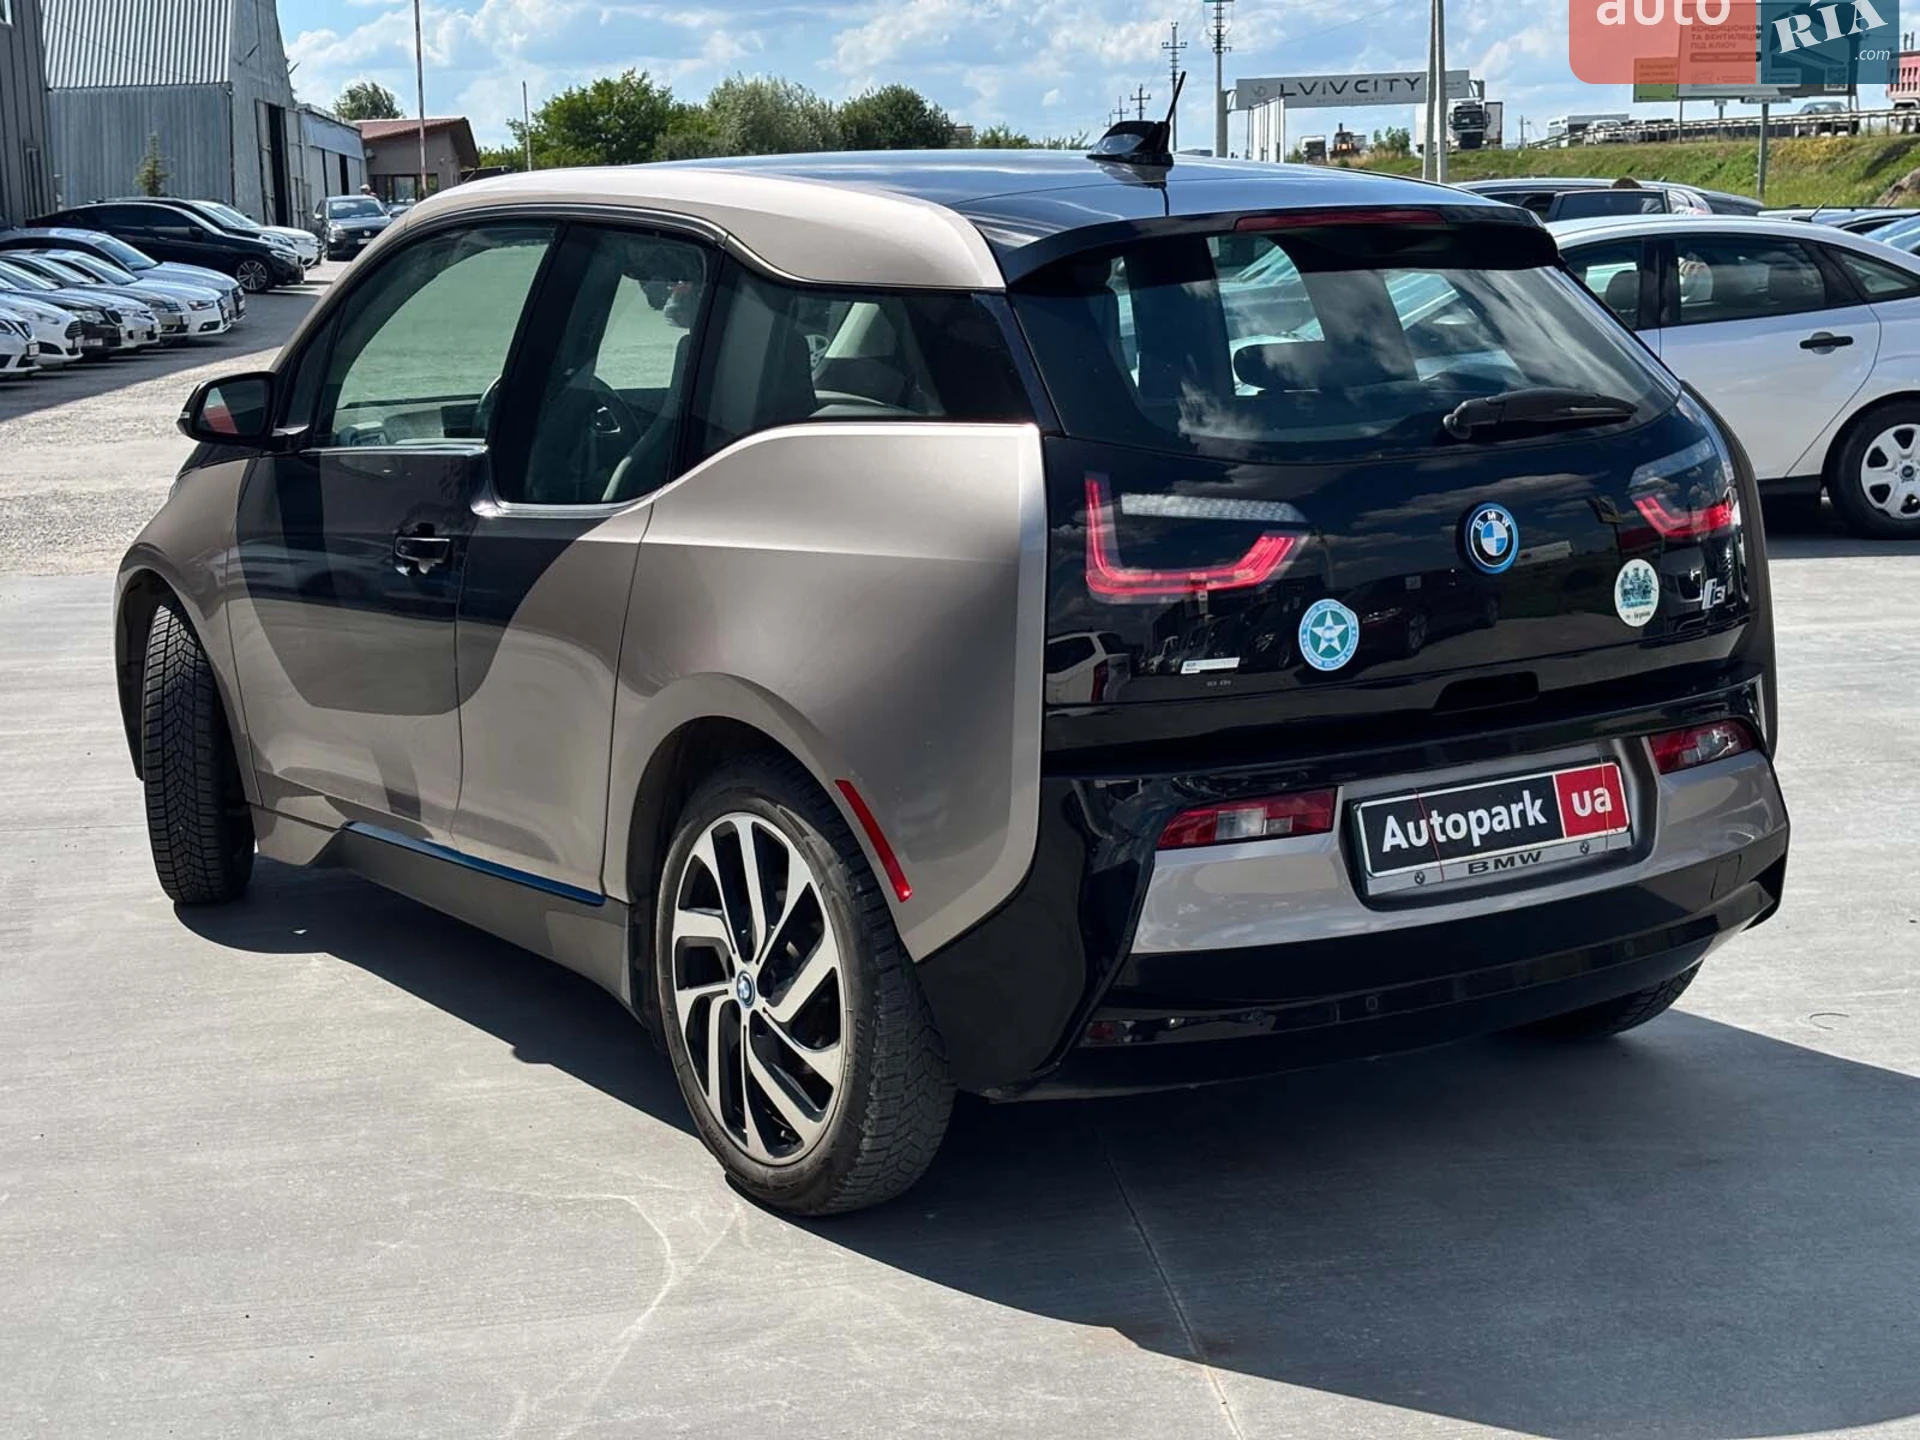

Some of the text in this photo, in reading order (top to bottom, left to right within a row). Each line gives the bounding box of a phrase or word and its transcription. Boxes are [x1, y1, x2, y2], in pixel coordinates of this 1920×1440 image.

[1475, 511, 1511, 530] BMW
[1701, 577, 1727, 610] i3
[1381, 787, 1613, 852] Autopark ua
[1468, 851, 1543, 875] BMW
